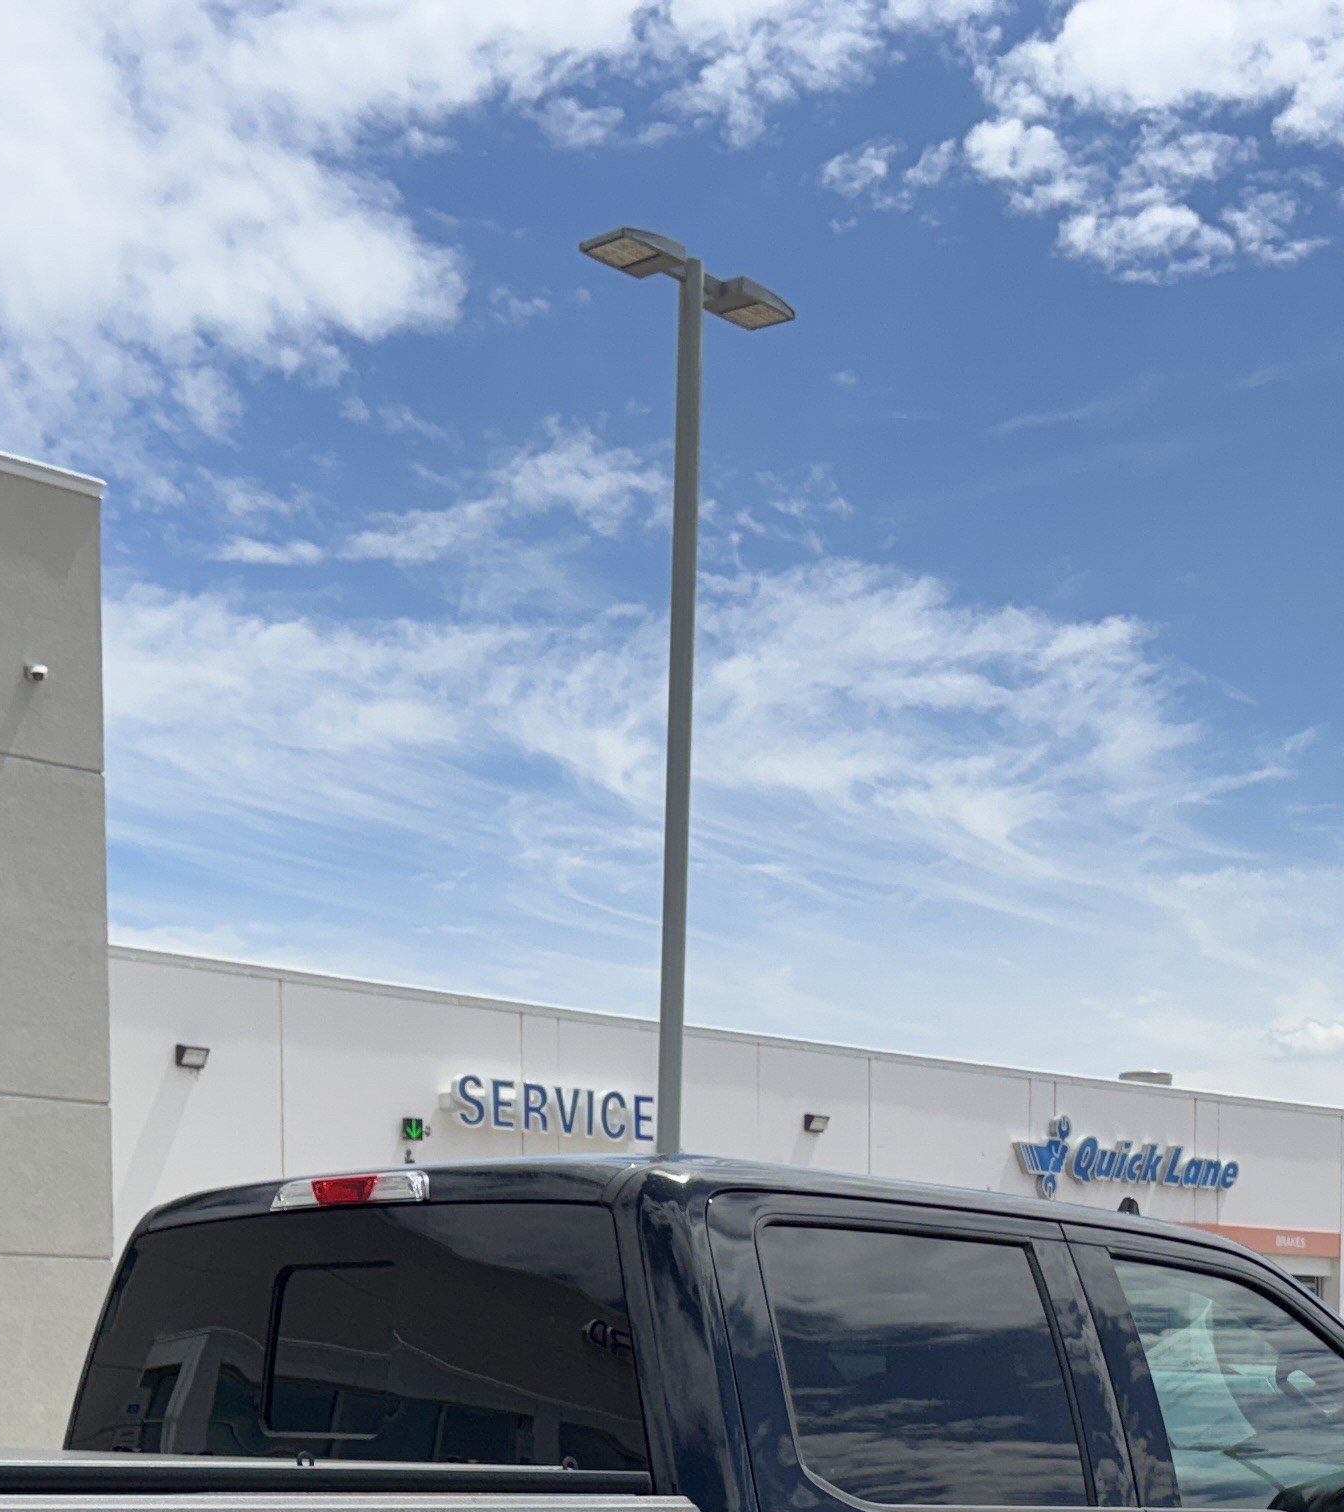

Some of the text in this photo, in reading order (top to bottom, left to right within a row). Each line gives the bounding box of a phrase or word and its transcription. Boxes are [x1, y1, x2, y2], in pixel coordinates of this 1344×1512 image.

[459, 1075, 654, 1141] SERVICE
[1071, 1136, 1239, 1189] Quick Lane
